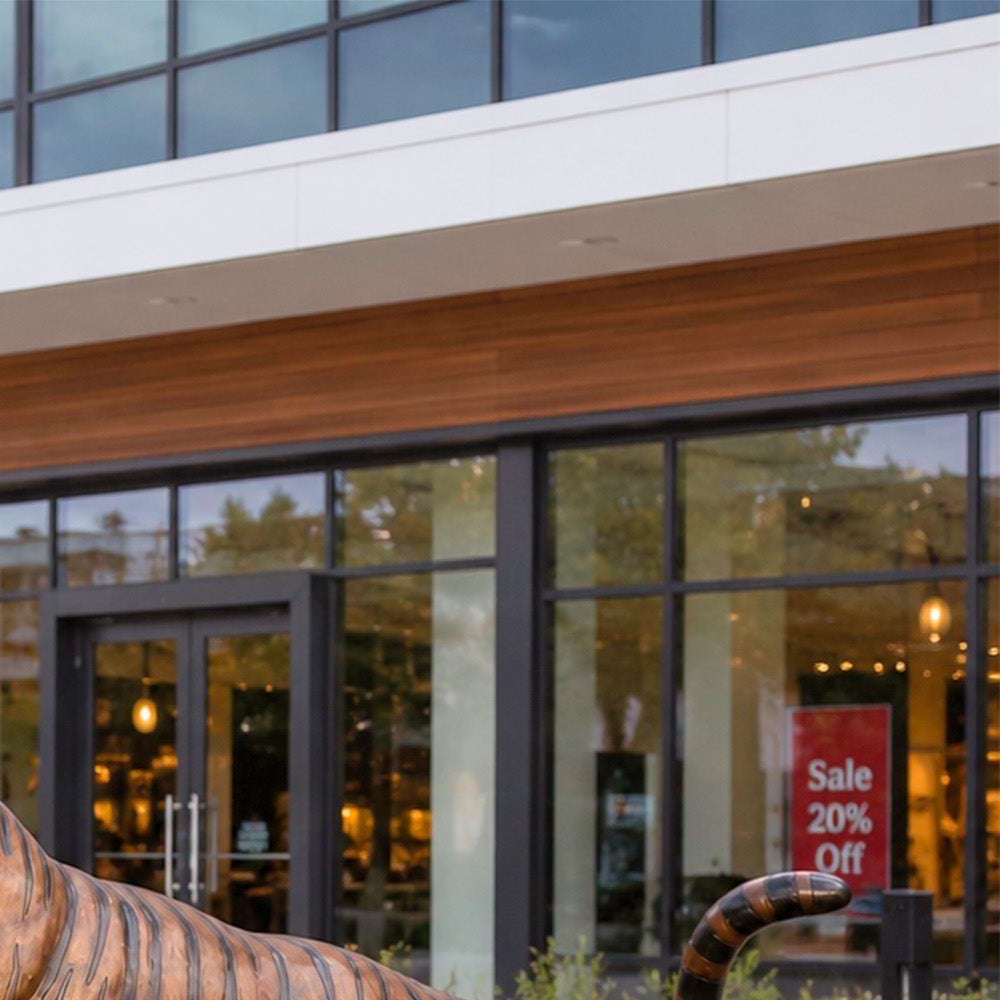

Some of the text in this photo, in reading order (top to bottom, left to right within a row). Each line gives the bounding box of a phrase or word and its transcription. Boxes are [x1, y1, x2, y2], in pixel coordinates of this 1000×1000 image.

[808, 758, 872, 791] Sale
[808, 803, 872, 833] 20%
[816, 842, 865, 874] Off
